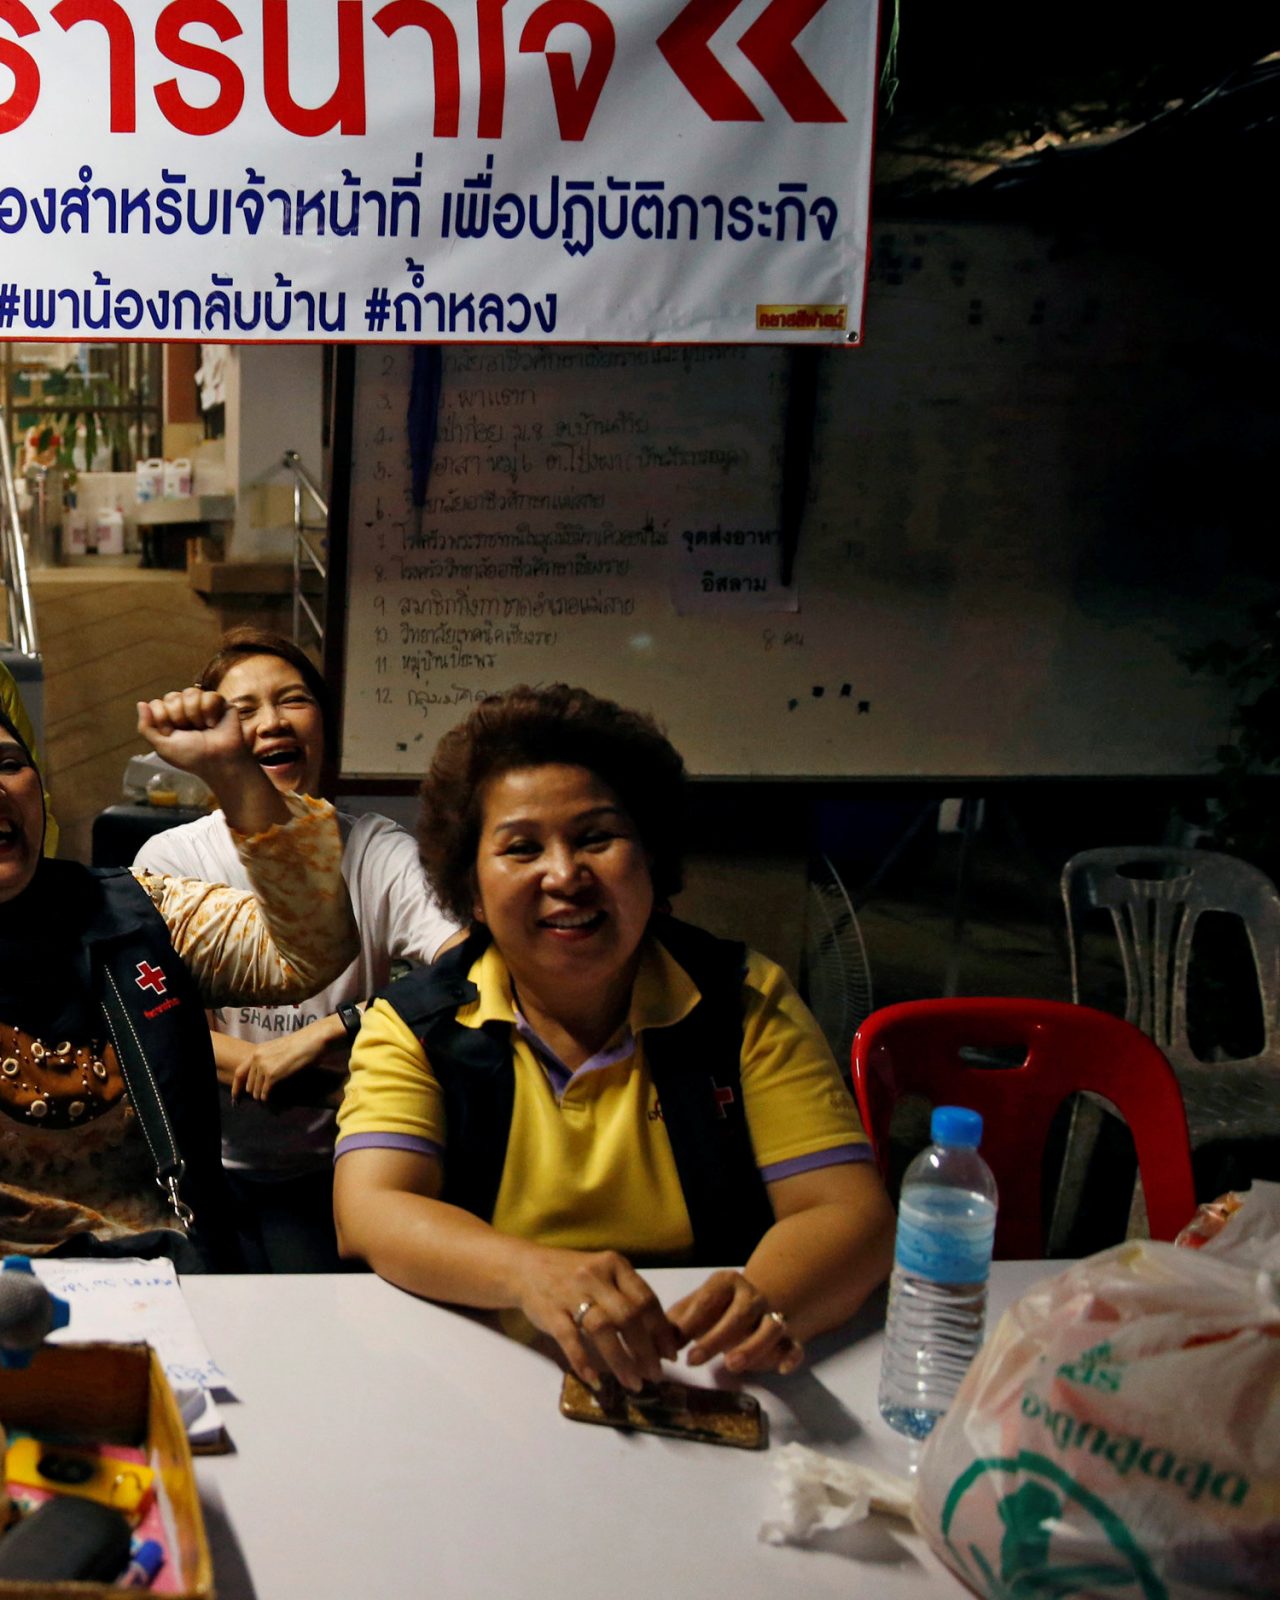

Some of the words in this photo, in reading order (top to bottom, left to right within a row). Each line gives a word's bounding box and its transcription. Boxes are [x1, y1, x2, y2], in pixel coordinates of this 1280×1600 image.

[441, 154, 839, 257] เพื่อปฏิบัติภาระกิจ
[364, 258, 558, 333] #ถ้ำหลวง
[681, 523, 783, 554] จุดส่งอาหา
[700, 569, 768, 593] อิสลาม
